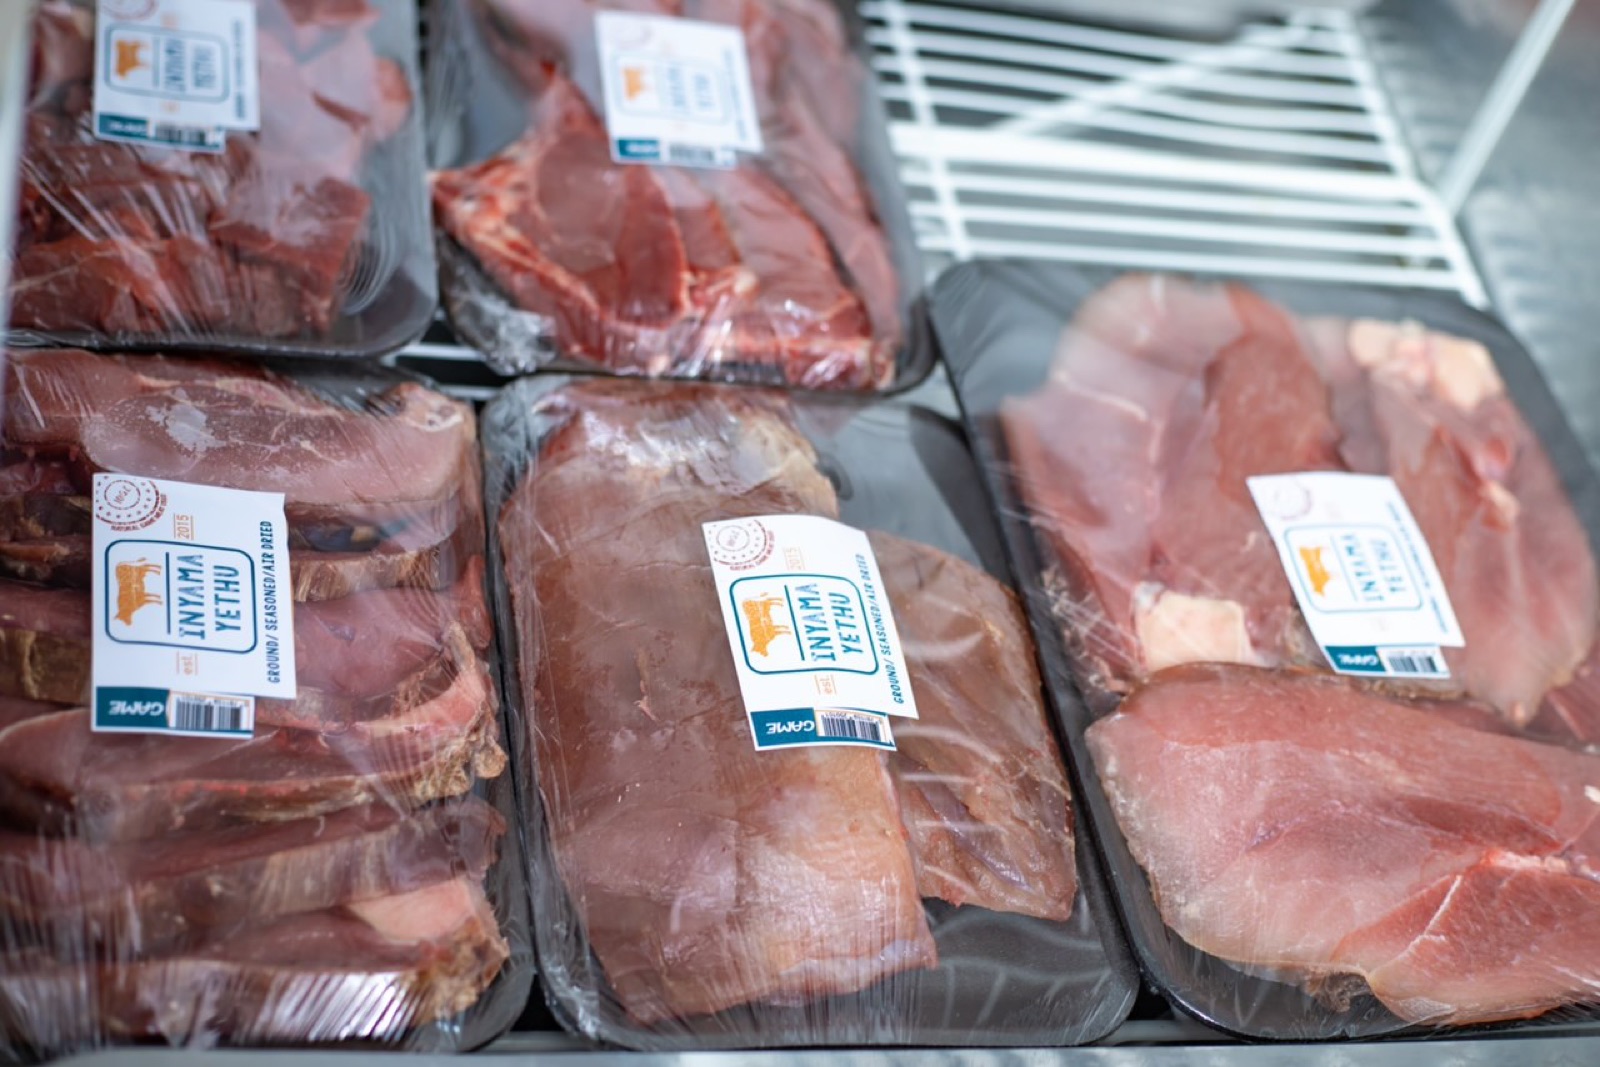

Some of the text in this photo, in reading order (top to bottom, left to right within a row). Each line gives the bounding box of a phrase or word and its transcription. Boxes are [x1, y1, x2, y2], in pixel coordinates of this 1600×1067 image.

[177, 514, 190, 539] 2015
[259, 521, 274, 550] DRIED
[855, 554, 871, 581] DRIED
[177, 554, 205, 640] INYAMA
[213, 565, 241, 632] YETHU
[795, 583, 836, 662] INYAMA
[829, 592, 863, 654] YETHU
[265, 634, 281, 683] GROUND/
[108, 700, 164, 716] GAME
[765, 720, 815, 735] GAME
